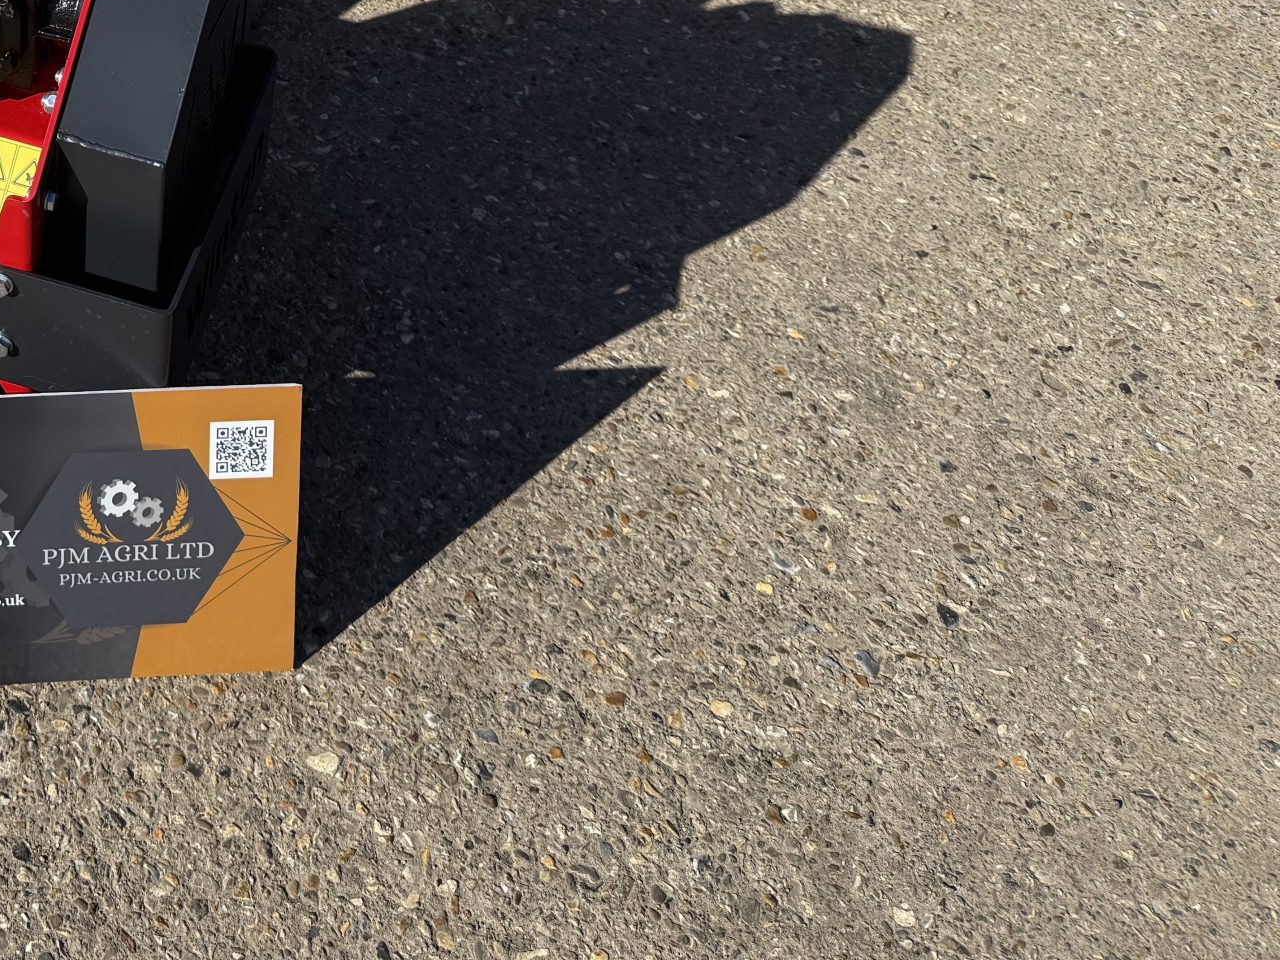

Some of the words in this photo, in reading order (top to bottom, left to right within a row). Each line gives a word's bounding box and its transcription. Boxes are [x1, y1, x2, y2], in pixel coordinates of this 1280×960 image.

[42, 546, 90, 569] PJM
[96, 544, 159, 563] AGRI
[166, 542, 215, 560] LTD
[59, 567, 201, 588] PJM-AGRI.CO.UK
